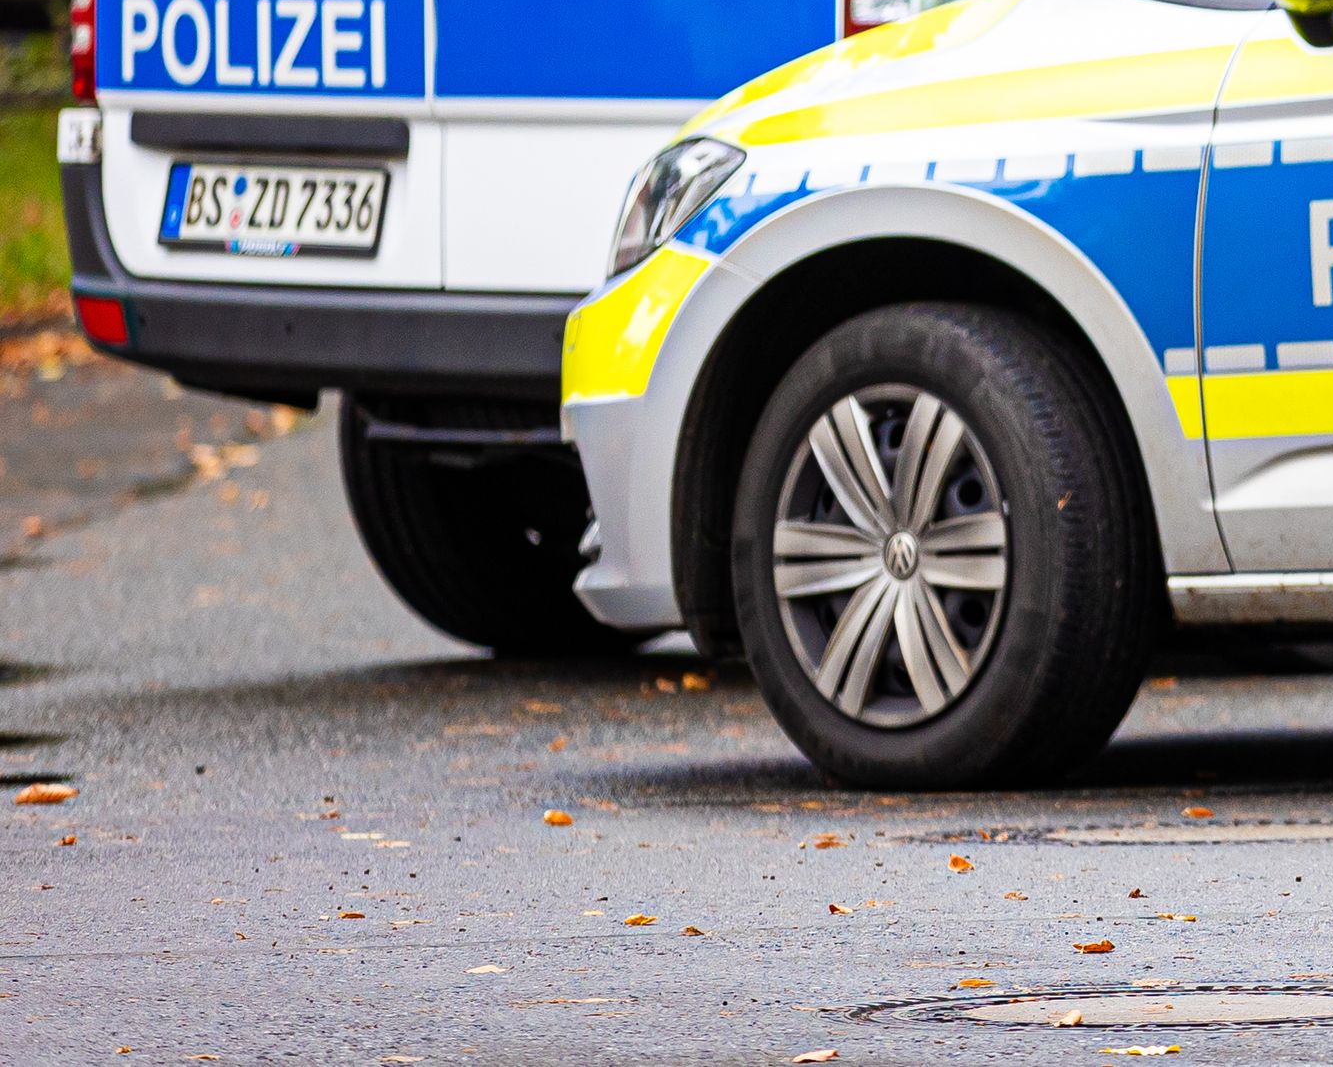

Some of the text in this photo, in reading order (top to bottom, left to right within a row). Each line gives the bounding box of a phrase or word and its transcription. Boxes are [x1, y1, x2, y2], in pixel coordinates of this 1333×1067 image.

[186, 176, 375, 231] BS ZD 7336
